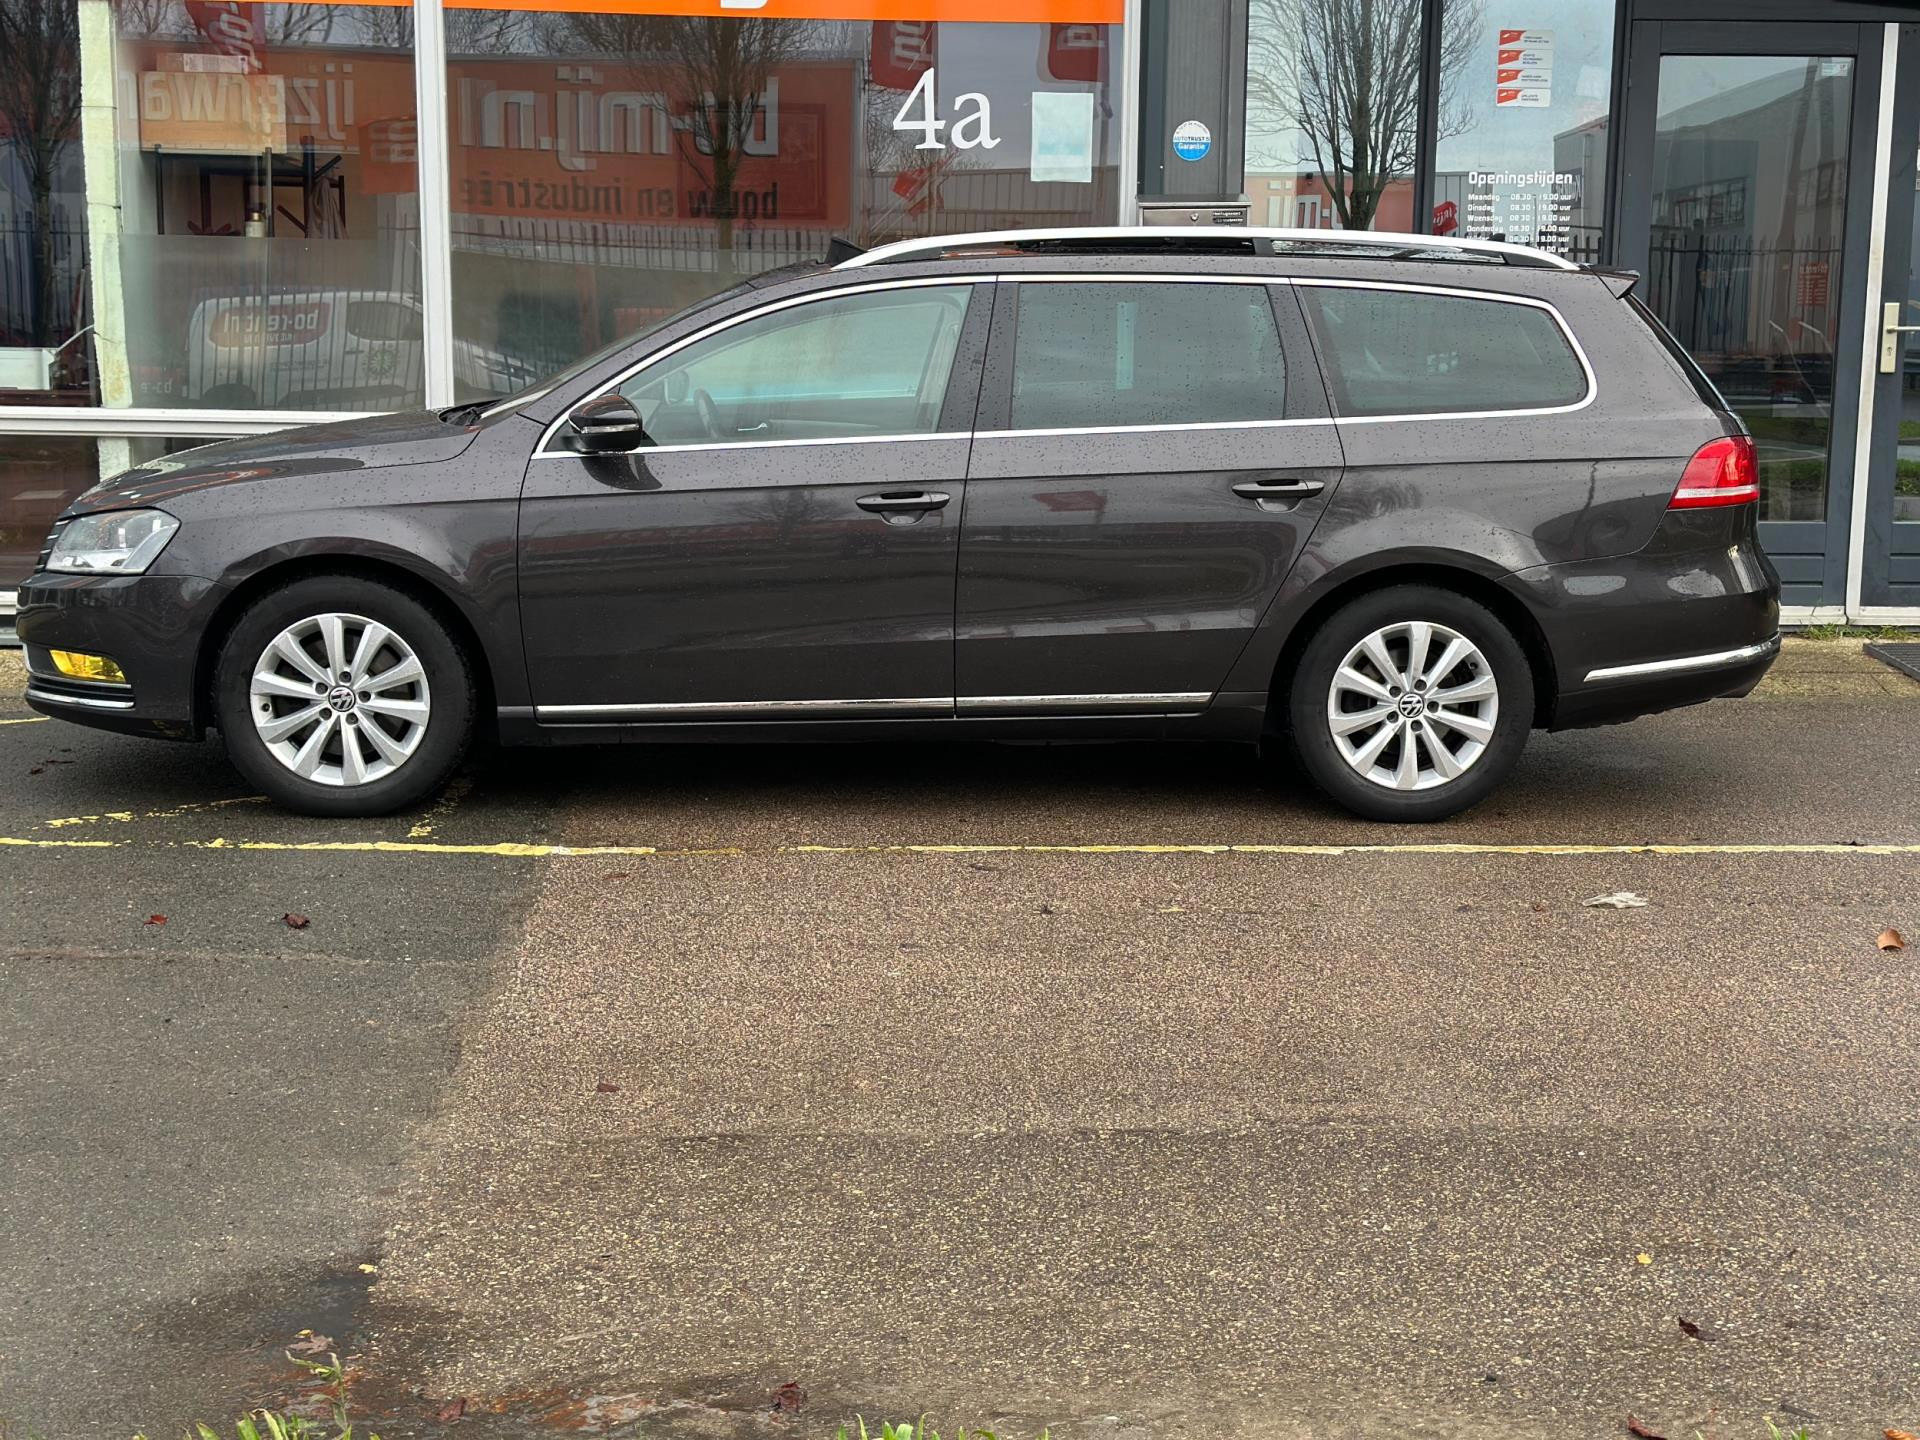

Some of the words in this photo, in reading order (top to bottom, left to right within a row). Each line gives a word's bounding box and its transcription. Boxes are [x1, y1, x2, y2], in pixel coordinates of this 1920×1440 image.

[892, 67, 1001, 152] 4a
[1468, 171, 1573, 187] Openingstijden
[1468, 193, 1500, 202] Maandag
[1468, 204, 1495, 212] Dinsdag
[1468, 214, 1502, 222] Woensdag
[1466, 225, 1504, 233] Donderdag
